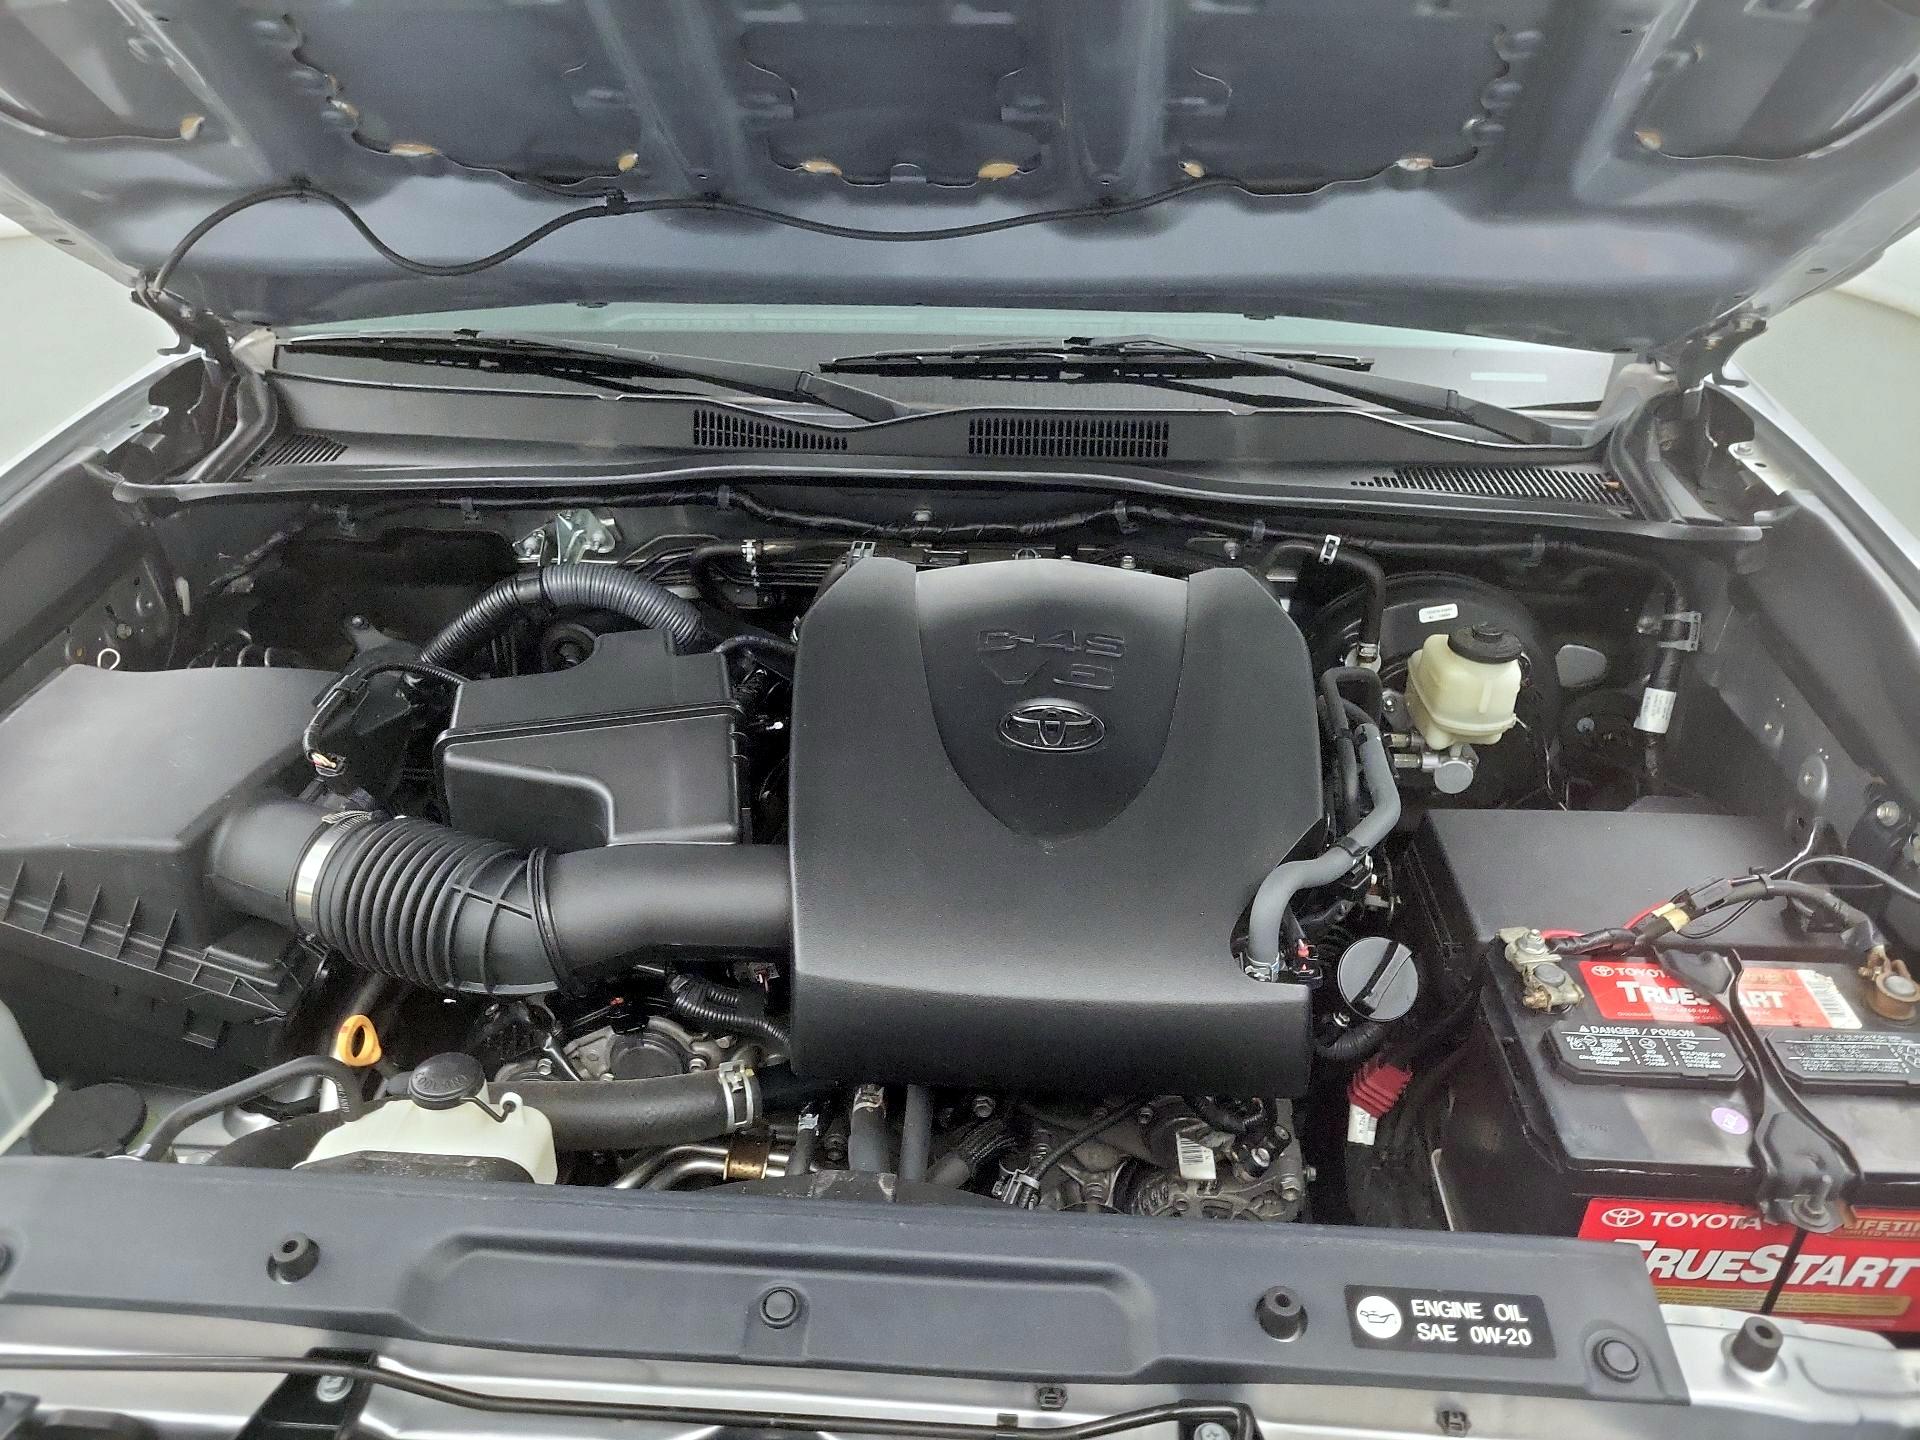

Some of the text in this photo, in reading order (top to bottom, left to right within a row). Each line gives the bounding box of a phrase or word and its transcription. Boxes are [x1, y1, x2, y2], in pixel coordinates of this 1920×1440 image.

[1614, 967, 1670, 979] TOYOT
[1590, 1025, 1640, 1035] DANGER
[1650, 1028, 1695, 1037] POISON
[1650, 1211, 1762, 1231] TOYOTA
[1411, 1299, 1528, 1322] ENGINE OIL
[1416, 1323, 1532, 1346] SAE 0W-20
